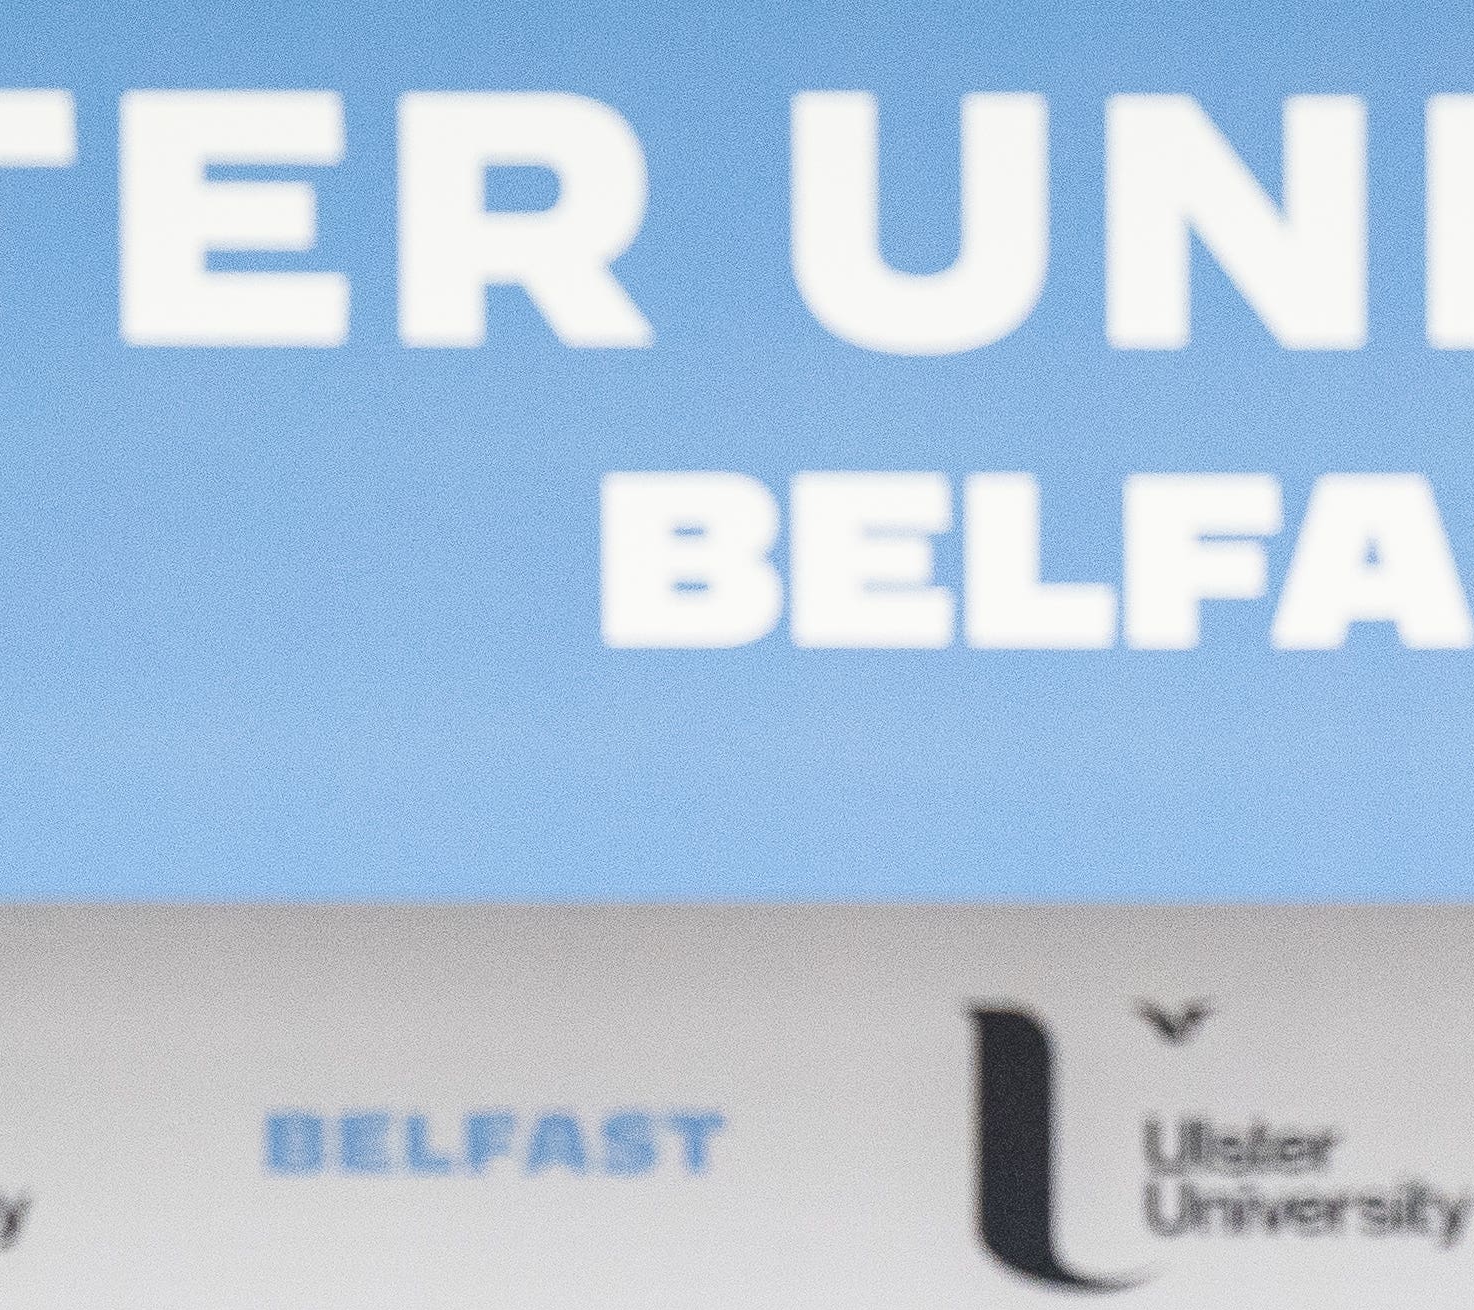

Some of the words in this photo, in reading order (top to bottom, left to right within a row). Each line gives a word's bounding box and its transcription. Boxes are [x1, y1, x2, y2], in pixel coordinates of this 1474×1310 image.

[261, 1107, 726, 1178] BELFAST
[1144, 1116, 1338, 1173] Ulster
[1143, 1180, 1471, 1246] University
